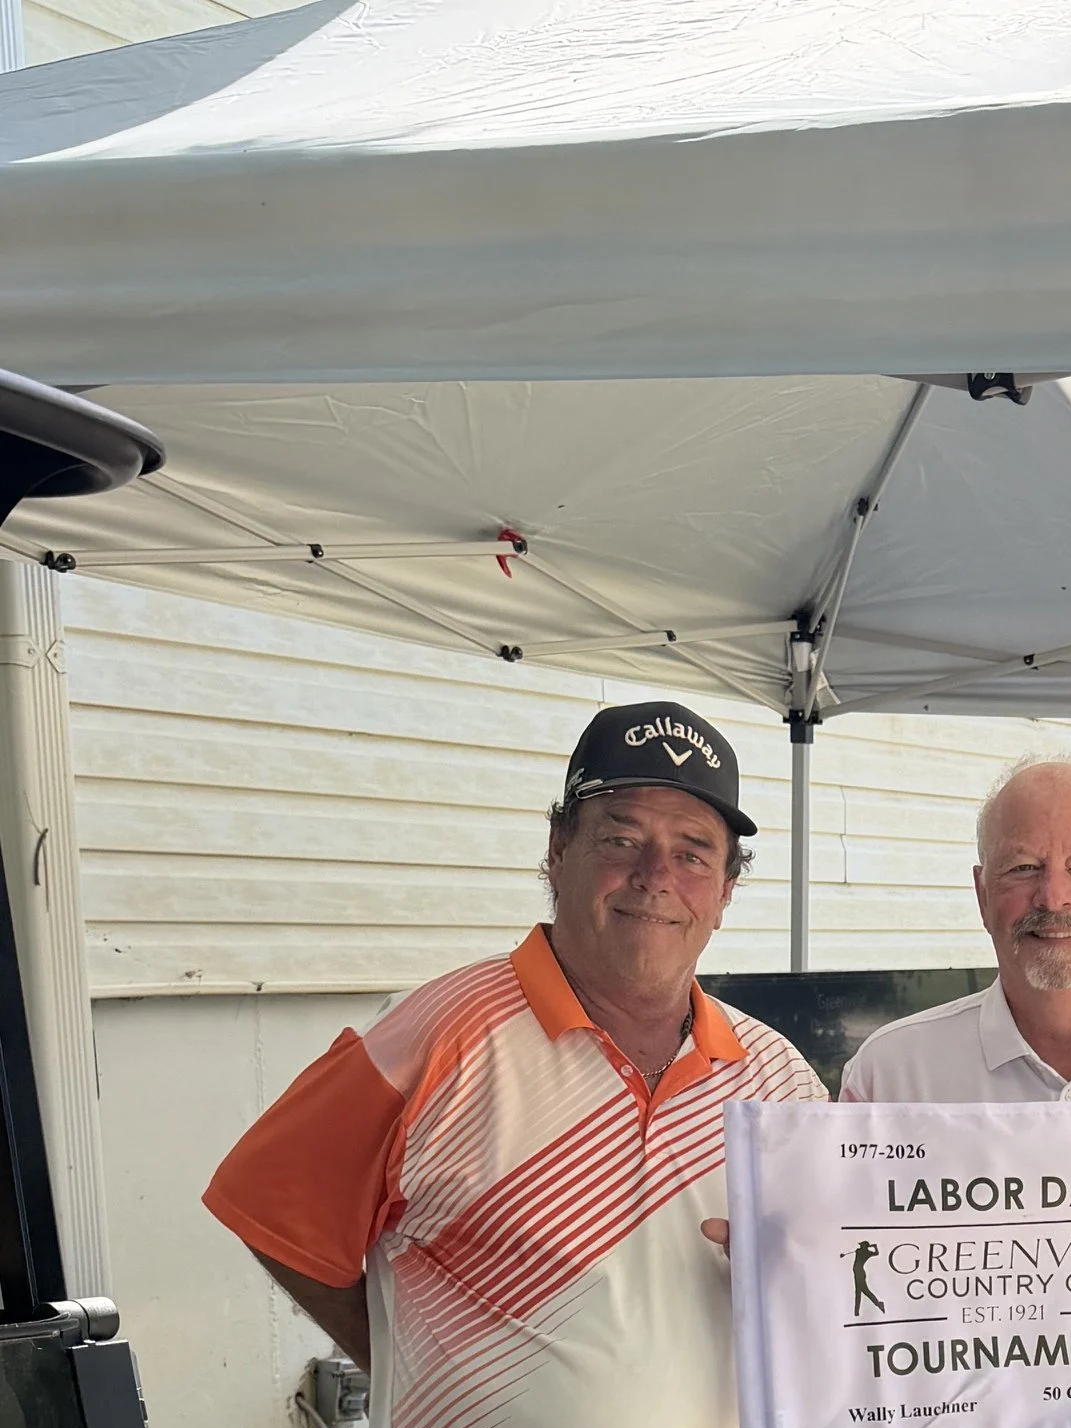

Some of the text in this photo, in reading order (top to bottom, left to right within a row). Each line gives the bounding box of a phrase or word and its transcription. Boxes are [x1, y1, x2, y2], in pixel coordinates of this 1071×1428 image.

[624, 716, 721, 769] Callaway
[840, 1143, 926, 1160] 1977-2026
[887, 1176, 1025, 1212] LABOR
[906, 1273, 1052, 1301] COUNTRY
[962, 1304, 1045, 1324] EST. 1921
[1042, 1386, 1062, 1401] 50
[848, 1401, 978, 1424] Wally Lauchner
